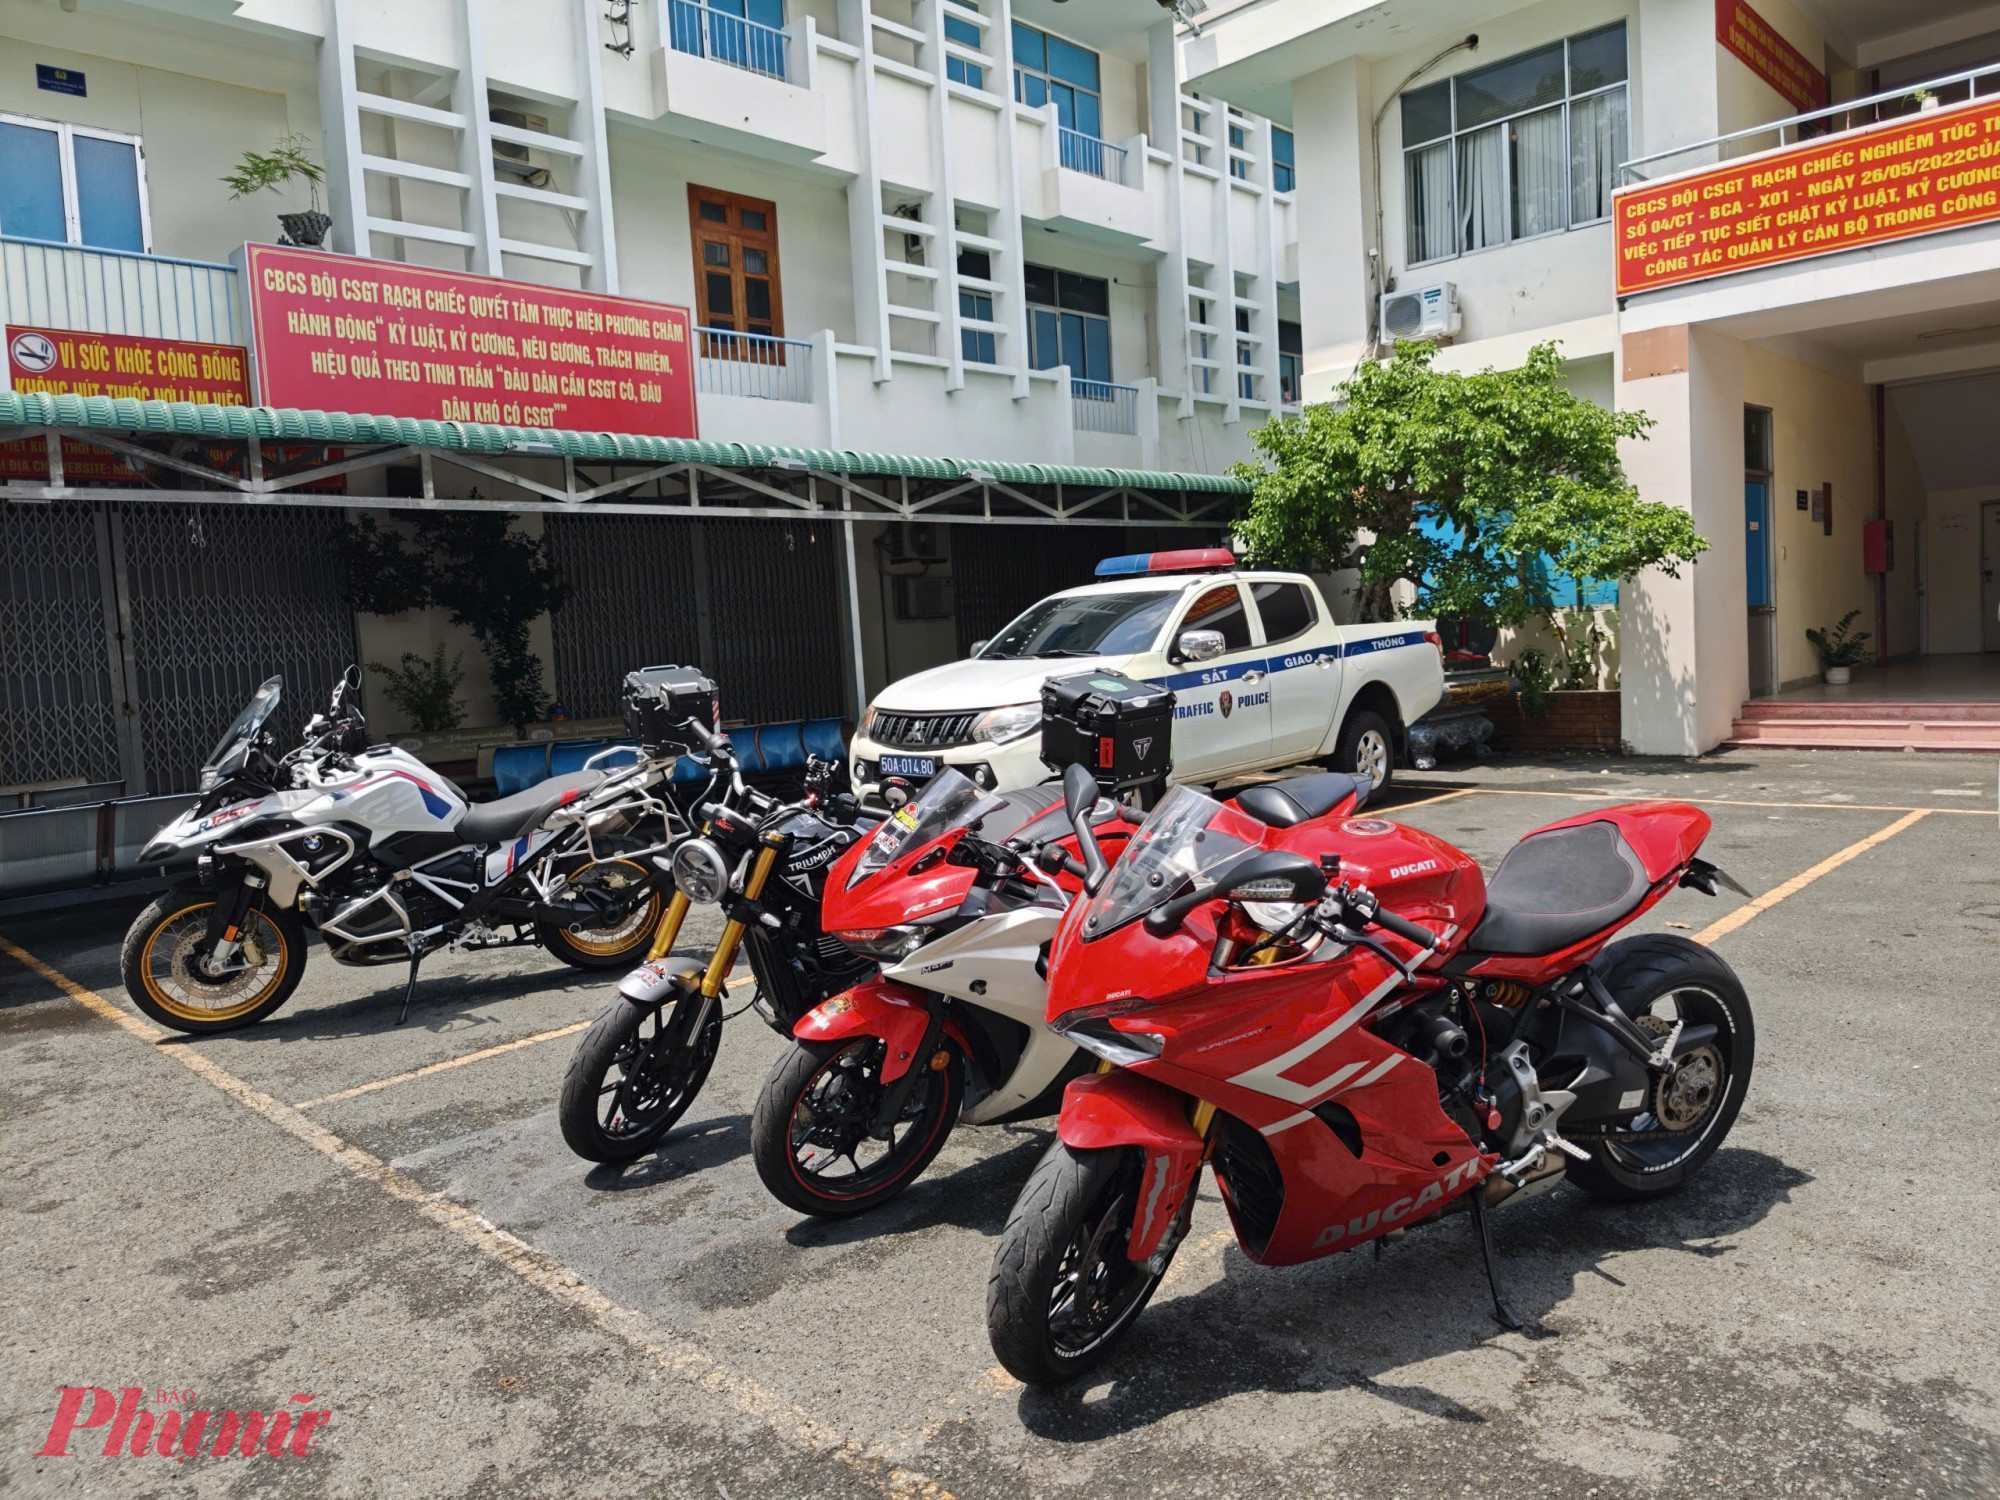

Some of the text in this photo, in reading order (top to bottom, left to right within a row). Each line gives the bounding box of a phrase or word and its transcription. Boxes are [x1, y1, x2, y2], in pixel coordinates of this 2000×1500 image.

[1626, 197, 1667, 219] CBCS
[1672, 189, 1698, 207] ĐỘI
[1703, 178, 1744, 200] CSGT
[1752, 165, 1797, 188] RẠCH
[1802, 149, 1854, 176] CHIẾC
[1860, 133, 1934, 162] NGHIÊM
[1940, 122, 1977, 143] TÚC
[1624, 241, 1658, 261] VIỆC
[1662, 230, 1696, 252] TIẾP
[1700, 225, 1731, 244] TỤC
[1736, 213, 1772, 236] SIẾT
[1776, 204, 1821, 227] CHẶT
[1825, 195, 1849, 216] KỶ
[1853, 187, 1900, 210] LUẬT,
[1906, 176, 1931, 198] KỶ
[1626, 218, 1647, 240] SỐ
[1651, 211, 1694, 234] 04/CT
[1710, 201, 1743, 220] BCA
[1759, 190, 1789, 209] X01
[1808, 173, 1856, 198] NGÀY
[1645, 190, 1997, 277] CÔNG TÁC QUẢN LÝ CÁN BỘ TRONG CÔNG
[264, 268, 683, 343] CBCS ĐỘI CSGT RẠCH CHIẾC QUYẾT TÂM THỰC HIỆN PHƯƠNG CHÂM
[59, 338, 241, 382] VÌ SỨC KHỎE CỘNG ĐỒNG
[288, 308, 332, 337] HÀNH
[389, 317, 406, 345] KỶ
[451, 325, 467, 351] KỶ
[471, 332, 520, 359] CƯƠNG,
[522, 335, 547, 360] NÊU
[550, 341, 594, 367] GƯƠNG,
[596, 345, 632, 368] TRÁCH
[311, 348, 347, 379] HIỆU
[351, 351, 381, 379] QUẢ
[385, 358, 420, 382] THEO
[423, 362, 455, 386] TINH
[459, 361, 494, 388] THẦN
[533, 370, 558, 394] DÂN
[561, 371, 585, 397] CẦN
[588, 379, 616, 399] CSGT
[640, 381, 662, 403] ĐÂU
[442, 396, 470, 422] DÂN
[473, 399, 500, 423] KHÓ
[503, 401, 520, 425] CÓ
[1201, 635, 1406, 685] SÁT GIAO THÔNG
[1173, 691, 1270, 720] TRAFFIC POLICE
[881, 756, 934, 775] 50A-014.80
[788, 845, 836, 871] TRIUMPH
[1390, 859, 1437, 879] DUCATI
[1106, 989, 1131, 1000] DUCATI
[1197, 1027, 1264, 1053] SUPERSPORT
[1312, 1156, 1481, 1250] DUCATI
